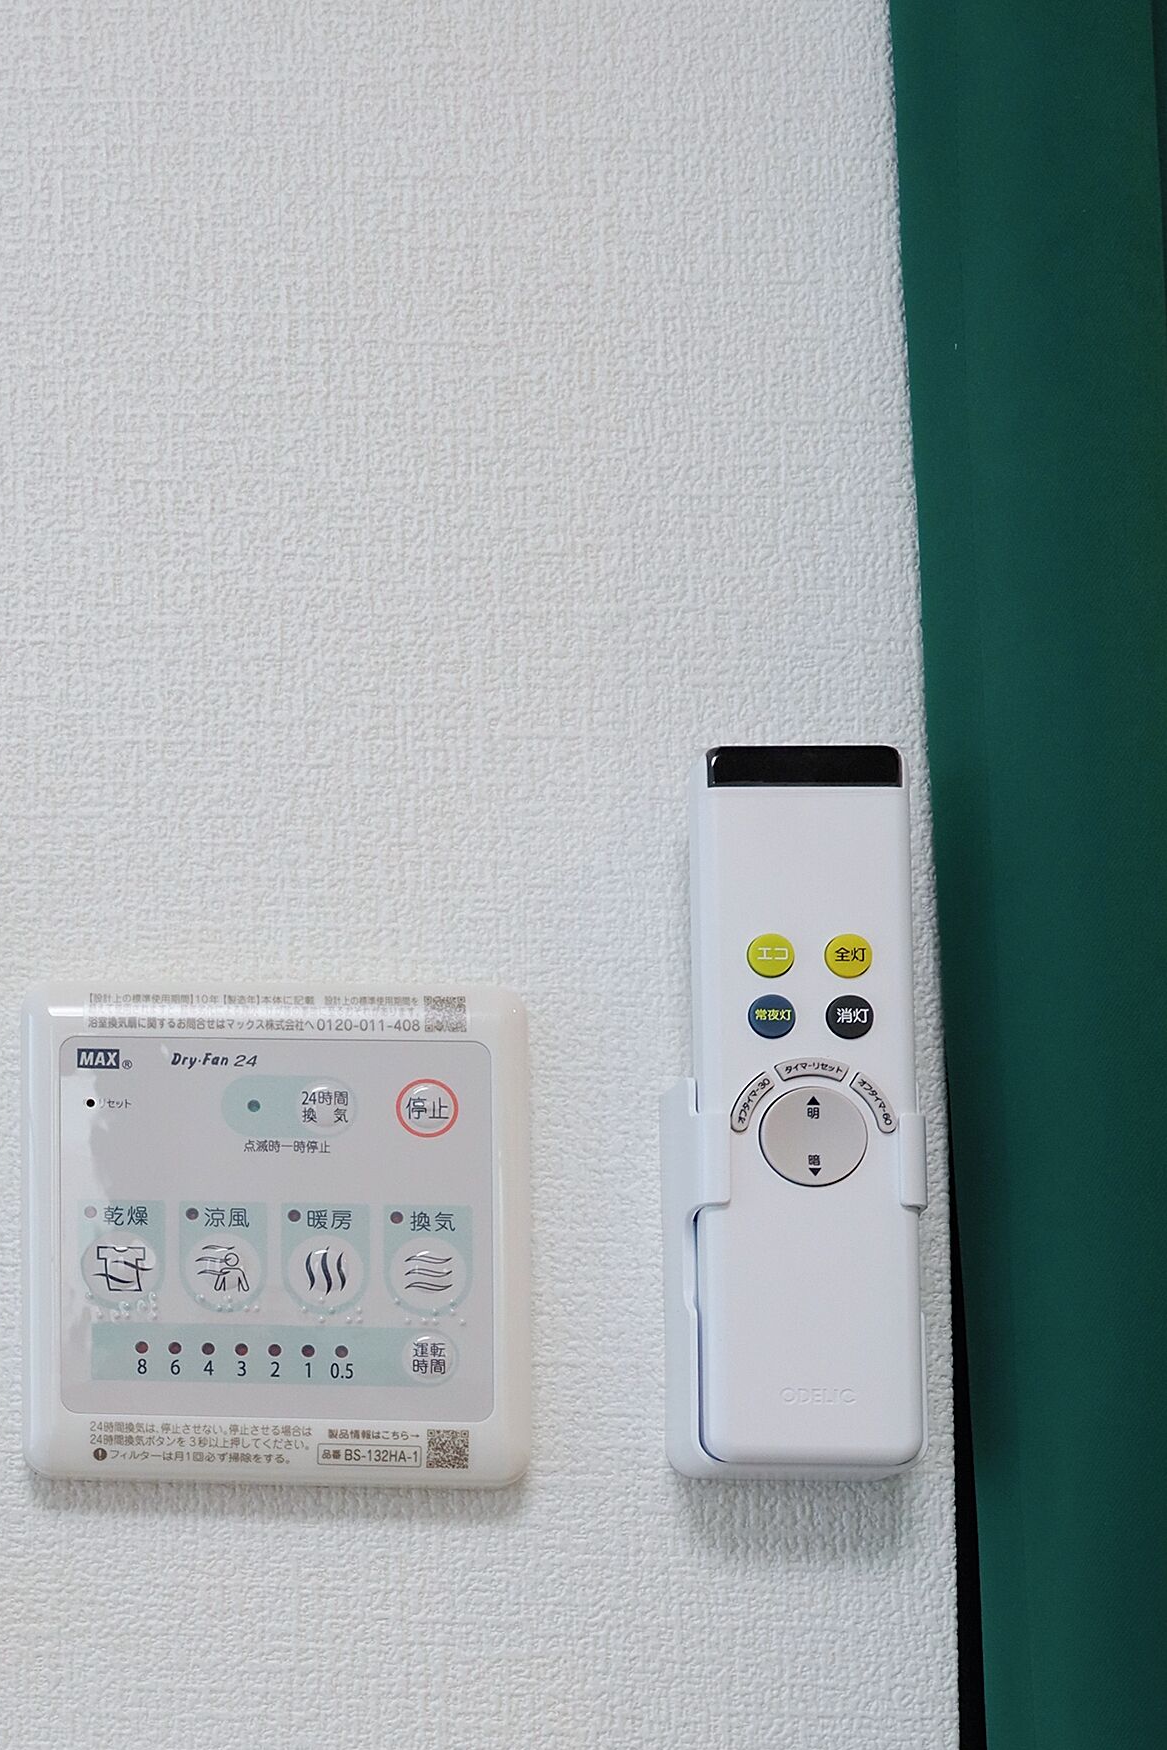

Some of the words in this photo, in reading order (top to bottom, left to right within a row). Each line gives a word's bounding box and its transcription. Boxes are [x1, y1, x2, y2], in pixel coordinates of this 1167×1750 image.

[756, 947, 789, 960] エコ
[835, 947, 867, 962] 全灯
[755, 1008, 792, 1021] 常夜灯
[836, 1007, 870, 1024] 消灯
[79, 1051, 119, 1068] MAX
[233, 1054, 258, 1067] 24
[98, 1098, 132, 1109] リセット
[301, 1090, 349, 1106] 24時間
[405, 1096, 450, 1120] 停止
[807, 1107, 820, 1119] 明
[243, 1139, 331, 1154] 点滅時一時停止
[808, 1154, 821, 1166] 暗
[102, 1205, 149, 1226] 乾燥
[204, 1207, 250, 1228] 涼風
[307, 1209, 353, 1230] 暖房
[410, 1211, 456, 1232] 換気
[412, 1341, 446, 1358] 運転
[137, 1359, 147, 1374] 8
[170, 1360, 181, 1375] 6
[203, 1360, 215, 1376] 4
[237, 1360, 247, 1377] 3
[270, 1361, 280, 1377] 2
[304, 1361, 312, 1378] 1
[330, 1362, 354, 1379] 0.5
[412, 1358, 446, 1375] 時間
[322, 1449, 342, 1460] 品番
[344, 1448, 418, 1463] BS-132HA-1
